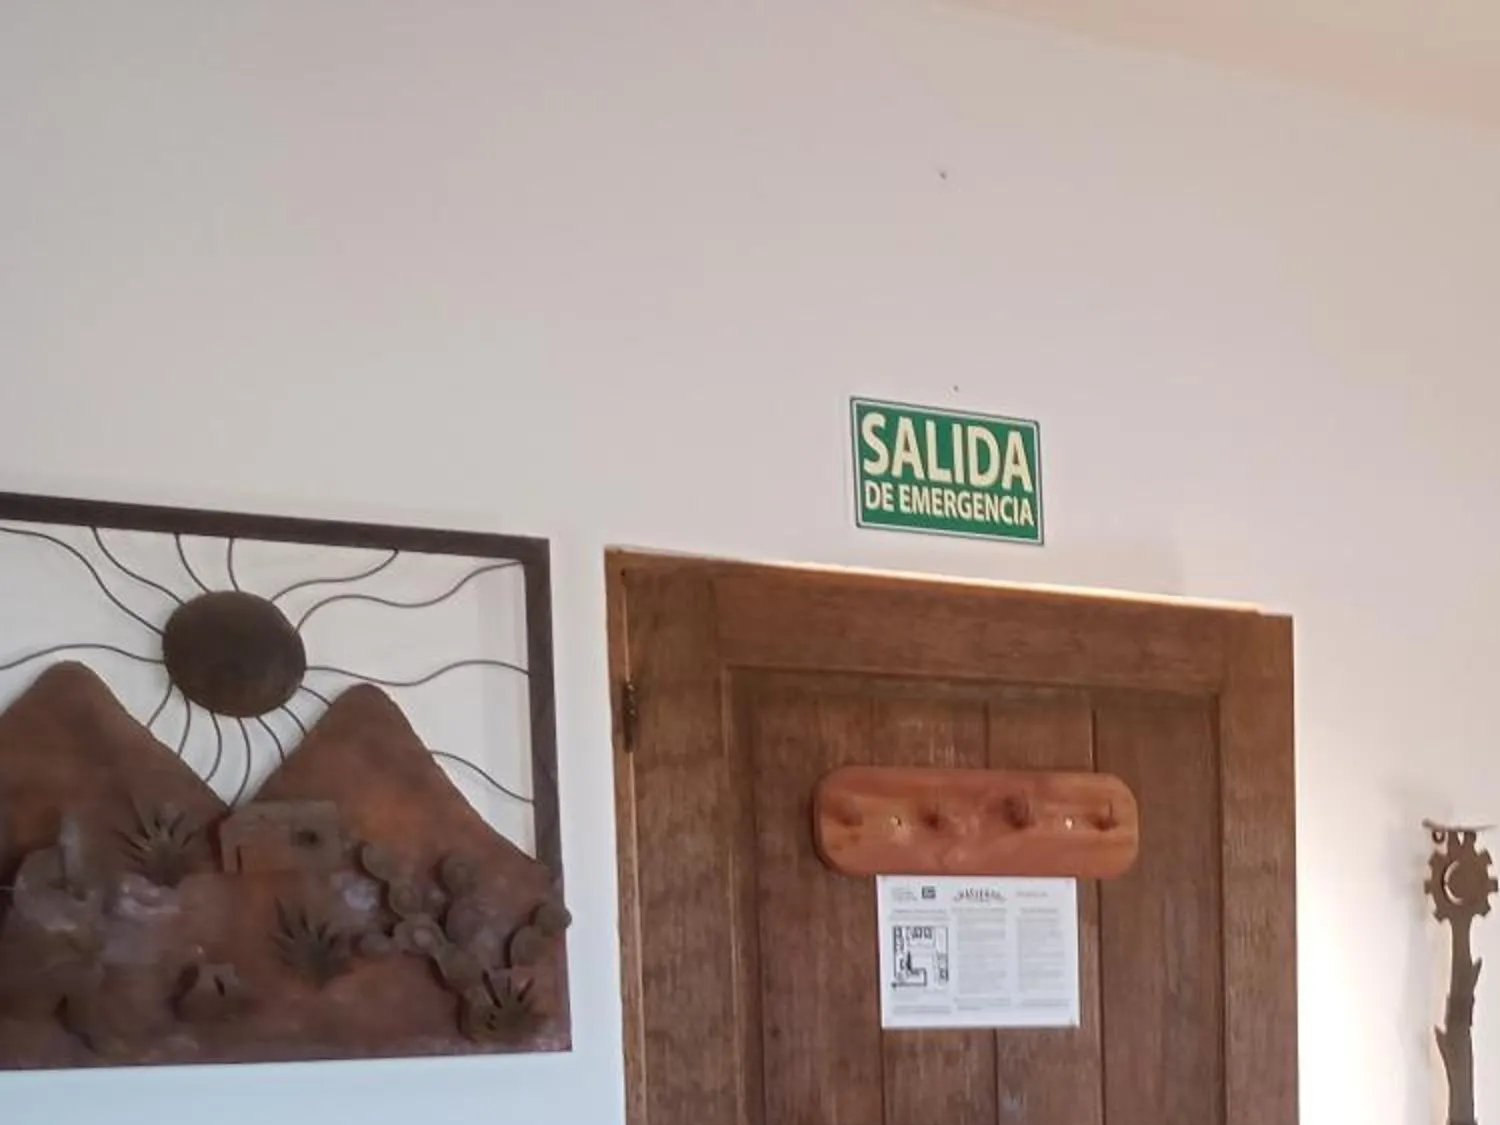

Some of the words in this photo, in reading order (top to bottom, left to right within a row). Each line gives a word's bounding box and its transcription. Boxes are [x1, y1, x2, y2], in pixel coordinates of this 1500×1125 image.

[861, 411, 1034, 493] SALIDA
[864, 480, 895, 512] DE
[899, 483, 1035, 527] EMERGENCIA
